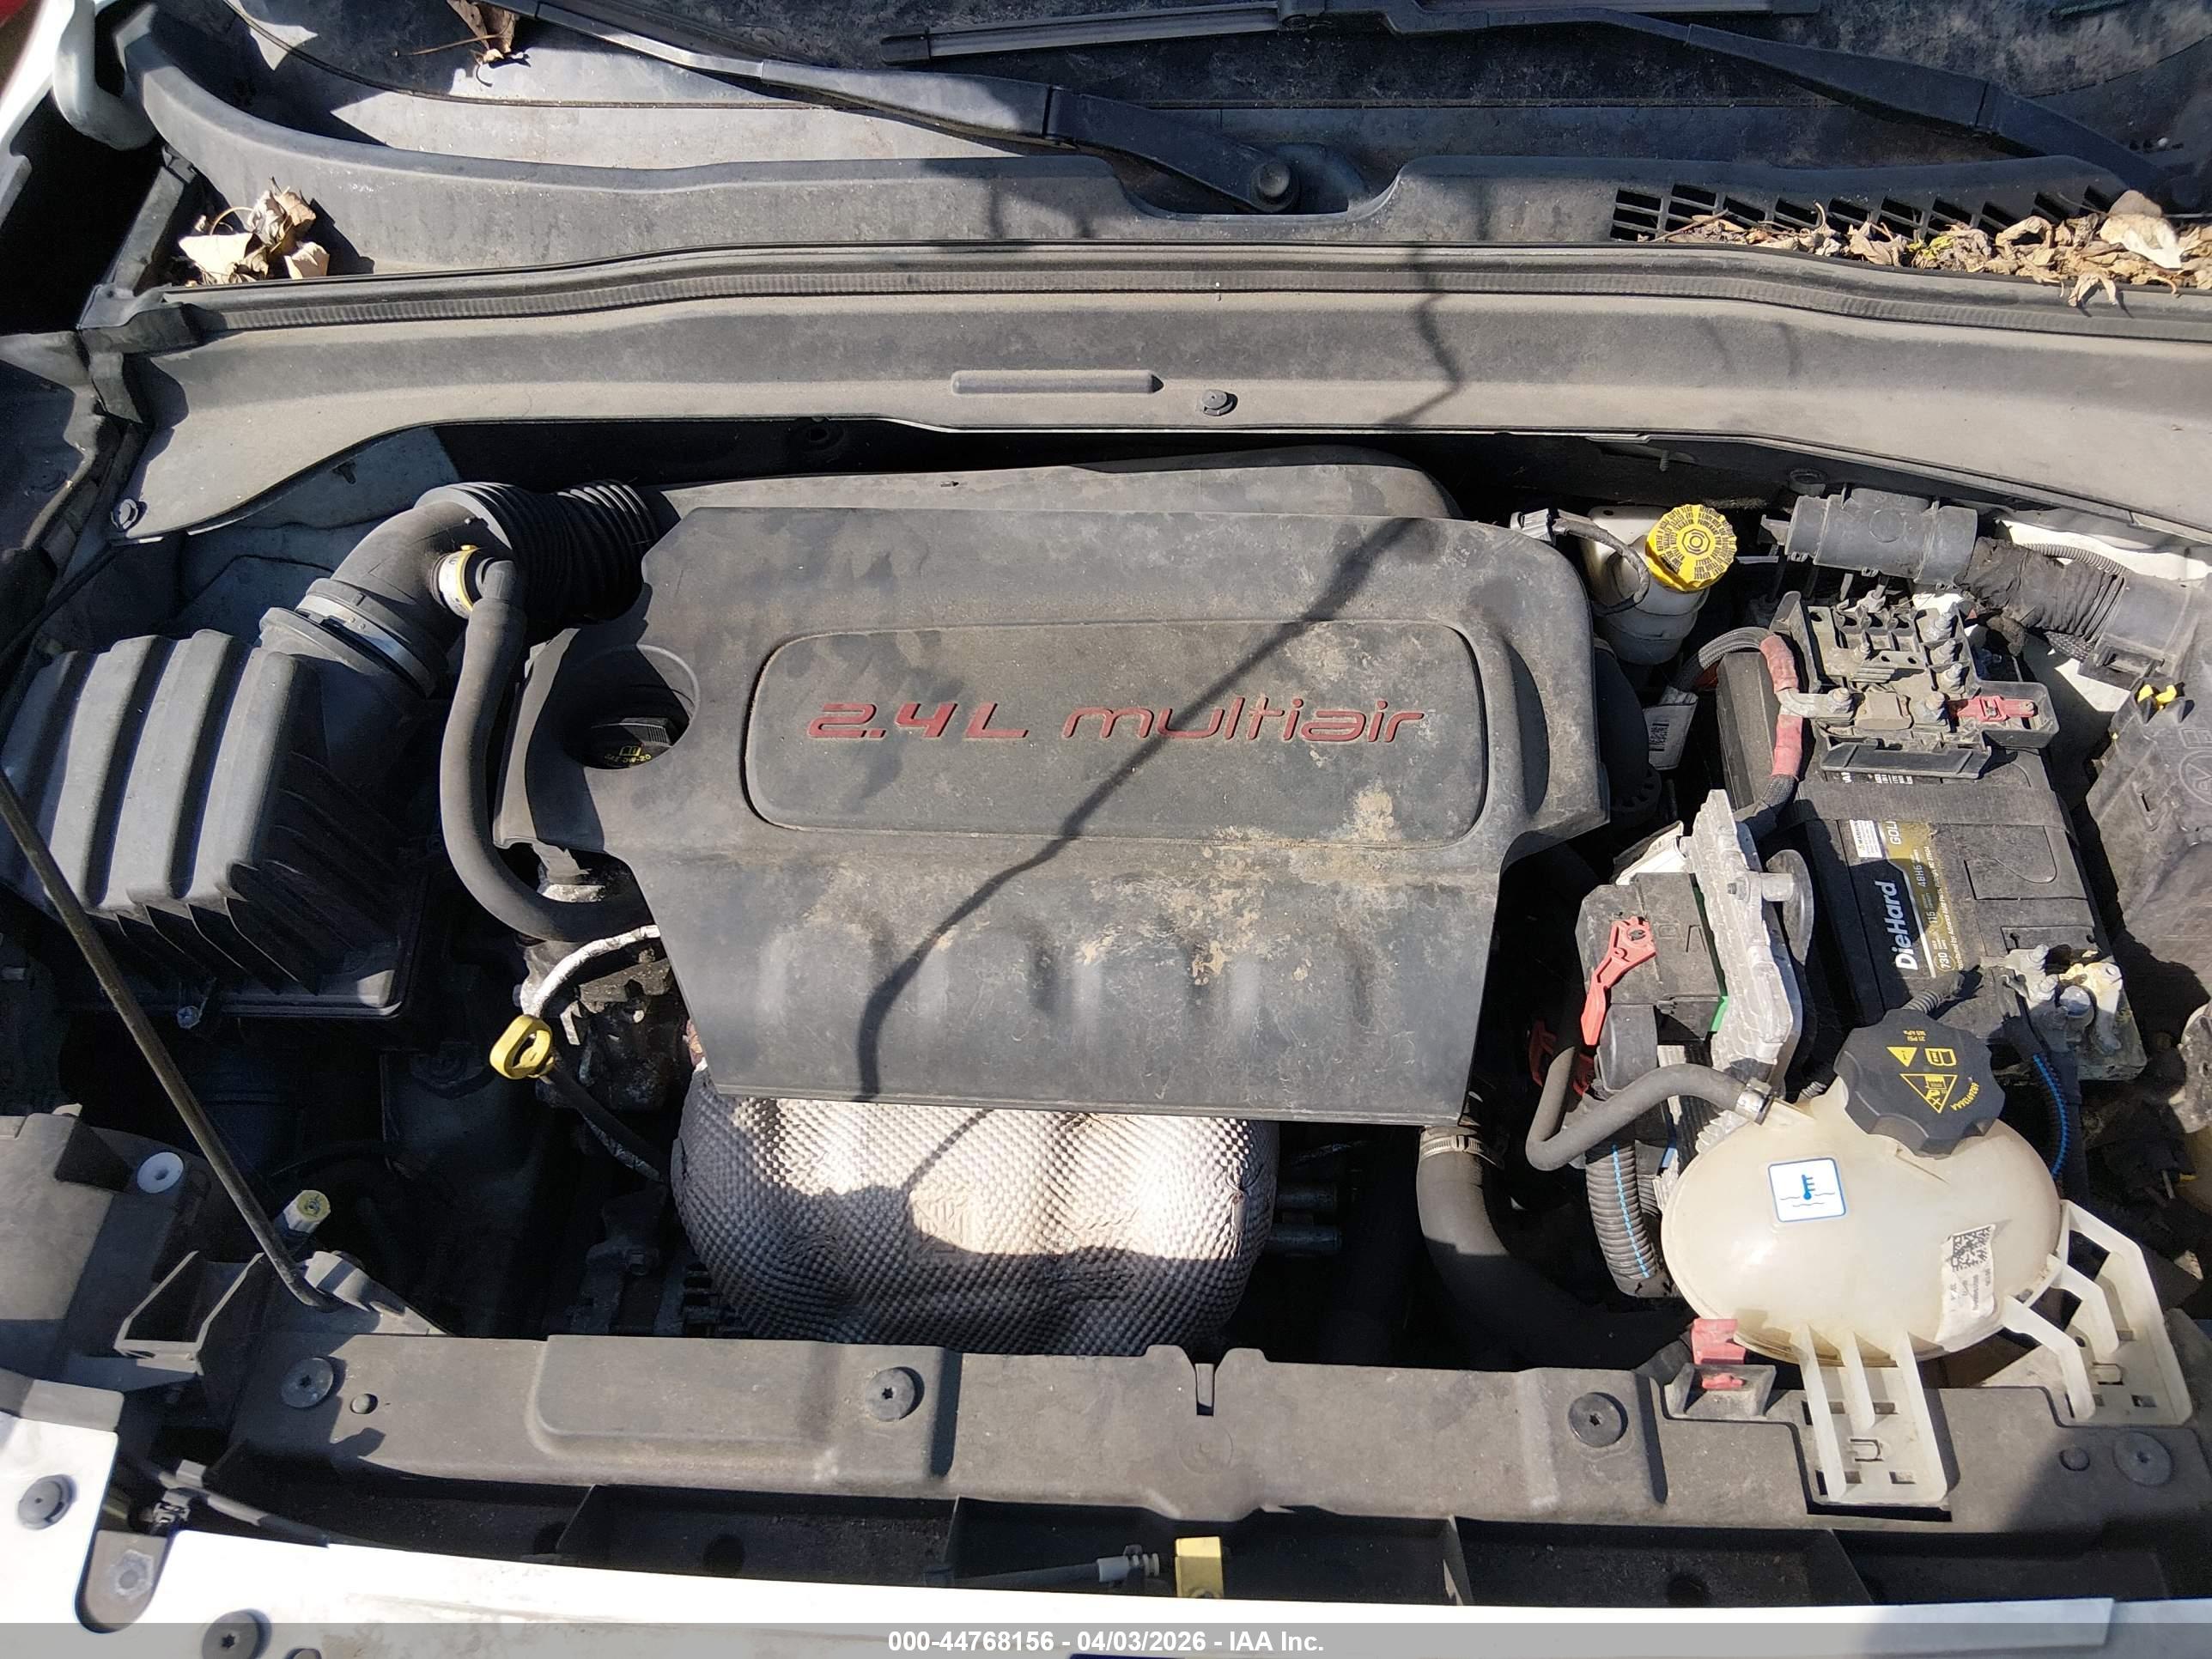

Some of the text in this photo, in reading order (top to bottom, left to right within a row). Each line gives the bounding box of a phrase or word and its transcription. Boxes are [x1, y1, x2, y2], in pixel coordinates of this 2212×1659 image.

[805, 696, 1427, 743] 2.4L multiair
[1875, 880, 1918, 970] DieHard
[1937, 953, 1951, 968] 730
